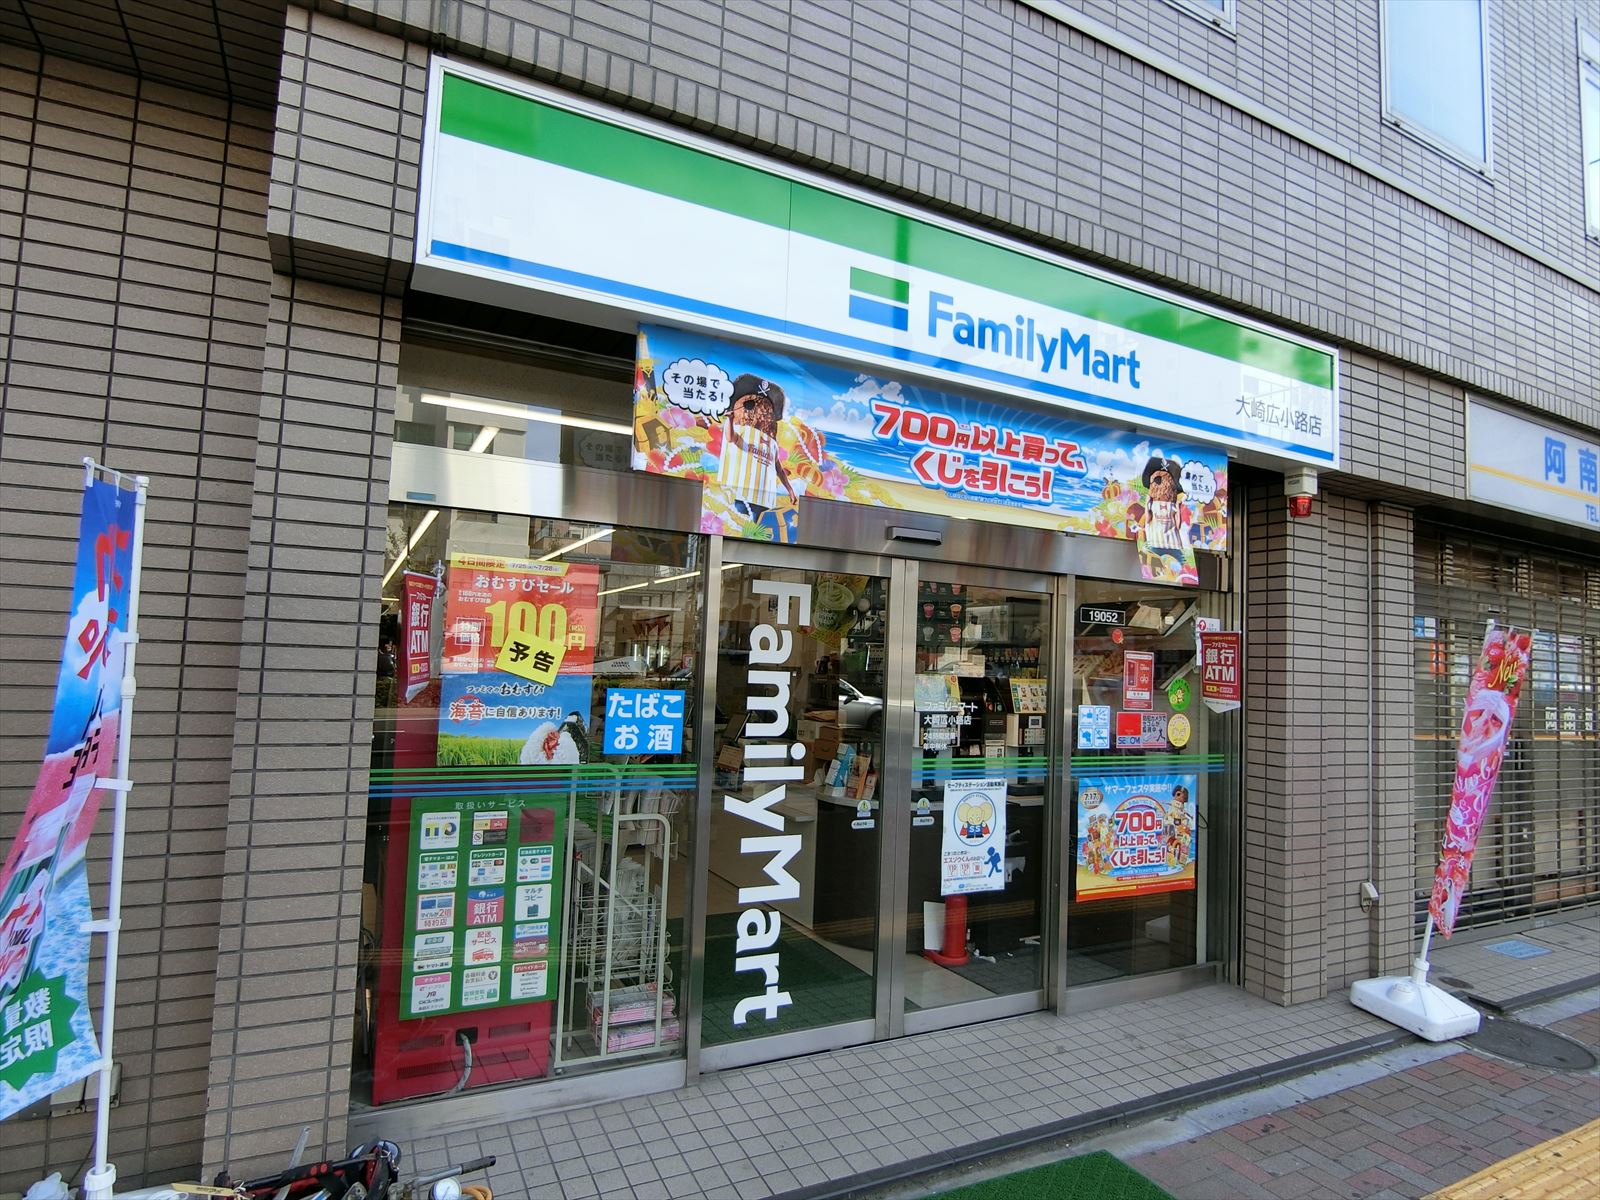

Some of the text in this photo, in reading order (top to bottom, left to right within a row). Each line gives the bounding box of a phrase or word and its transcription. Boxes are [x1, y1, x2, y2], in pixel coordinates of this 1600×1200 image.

[927, 291, 1141, 389] FamilyMart
[671, 373, 721, 388] その場で
[683, 387, 725, 402] 当たる!
[1235, 395, 1323, 437] 大崎広小路店
[874, 403, 1085, 470] 700円以上買って、
[1544, 436, 1598, 493] 阿南
[913, 450, 1052, 499] くじを引こう!
[1585, 504, 1599, 522] TEL
[475, 575, 574, 594] おむすびセール
[411, 602, 429, 628] 銀行
[1089, 610, 1118, 623] 19052
[411, 630, 429, 654] ATM
[567, 634, 586, 651] 円
[509, 640, 556, 674] 予告
[1205, 648, 1234, 665] 銀行
[1205, 665, 1234, 682] ATM
[449, 702, 562, 720] 海苔に自信あります!
[608, 692, 683, 719] たばこ
[924, 701, 978, 713] ファミリーマート
[614, 724, 675, 751] お酒
[1118, 737, 1141, 745] SEOM
[455, 799, 526, 810] 取扱いサービス
[724, 579, 812, 1026] FamilyMart
[1115, 811, 1162, 833] 700円
[1110, 848, 1166, 867] くじを引こう!
[473, 902, 499, 915] 銀行
[473, 914, 497, 924] ATM
